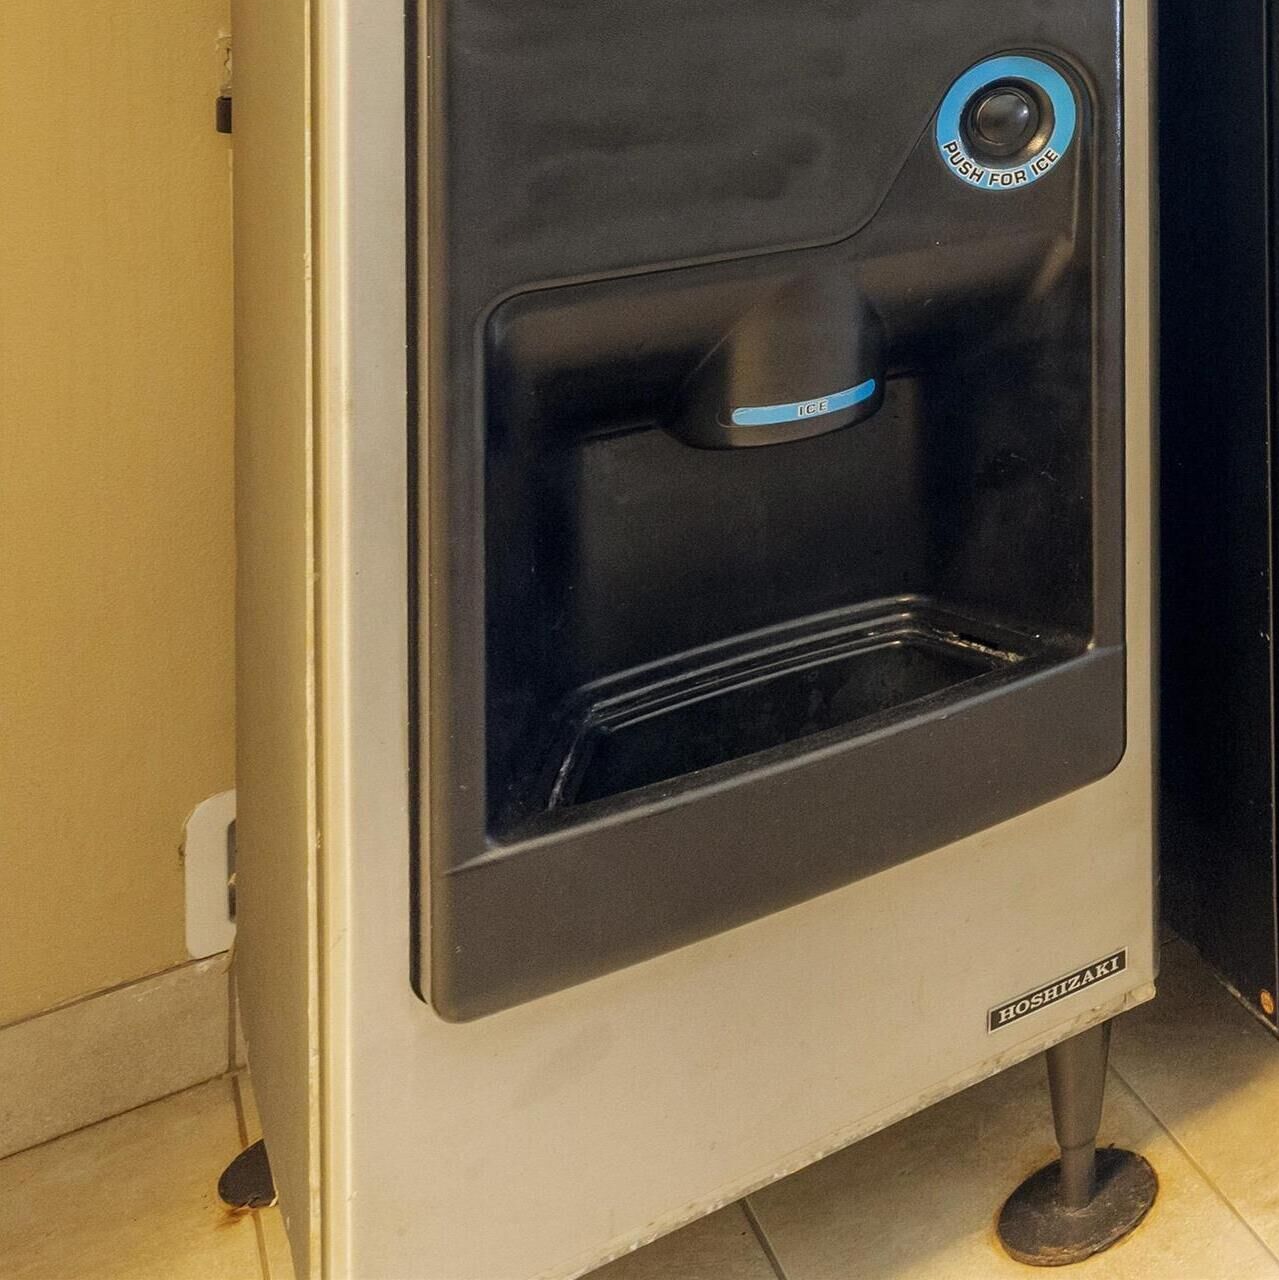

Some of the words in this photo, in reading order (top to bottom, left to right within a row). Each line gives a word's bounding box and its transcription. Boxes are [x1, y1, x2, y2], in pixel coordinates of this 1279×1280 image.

[943, 141, 985, 182] PUSH
[988, 169, 1027, 186] FOR
[1031, 149, 1058, 176] ICE
[799, 402, 828, 415] ICE
[997, 956, 1120, 1024] HOSHIZAKI
